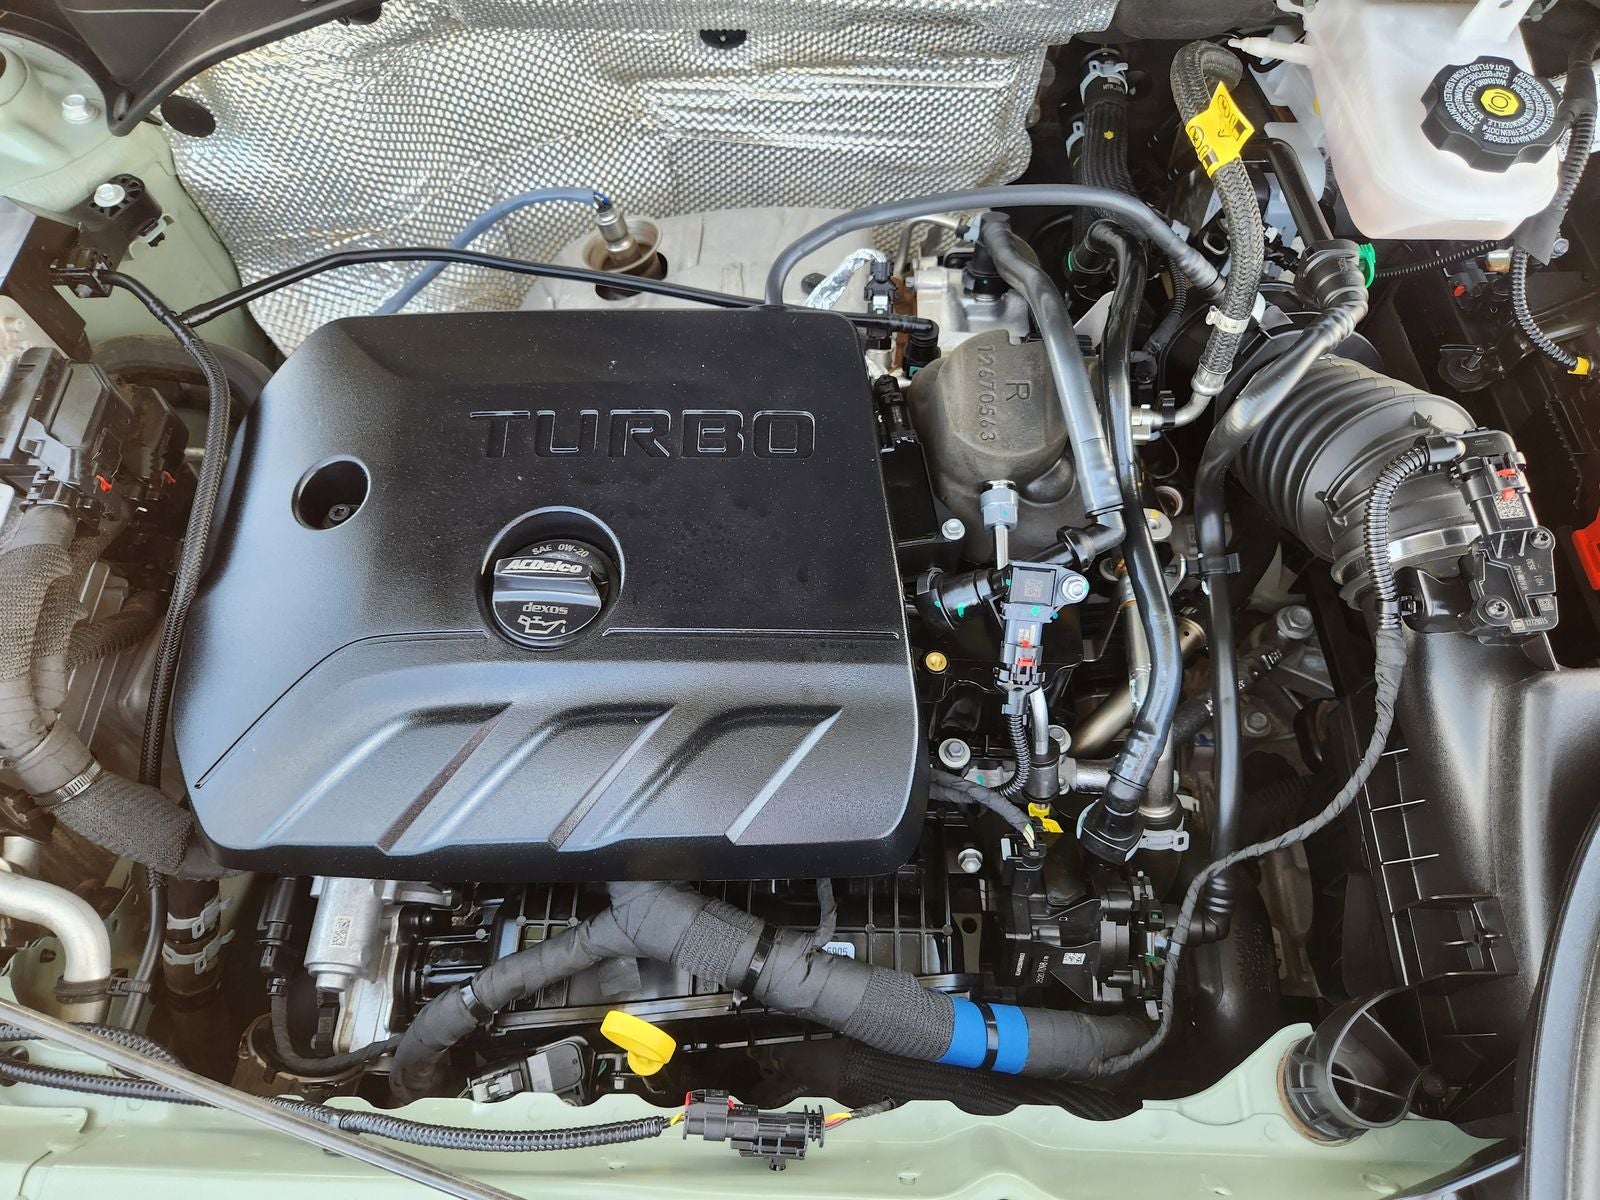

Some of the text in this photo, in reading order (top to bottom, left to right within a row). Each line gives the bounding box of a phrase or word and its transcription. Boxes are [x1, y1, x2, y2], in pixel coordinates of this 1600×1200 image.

[1451, 67, 1471, 81] FROM
[1469, 63, 1489, 72] FLUID
[1492, 71, 1508, 79] CAP
[1495, 64, 1510, 73] DOT
[1466, 70, 1493, 81] BEFORE
[1443, 81, 1456, 102] SEALED
[1461, 111, 1480, 126] ONLY
[977, 344, 996, 441] 12670563
[1005, 381, 1031, 402] R
[469, 408, 816, 459] TURBO
[531, 543, 590, 558] SAE 0W-20
[504, 558, 583, 574] ACDelco
[521, 601, 569, 615] dexos
